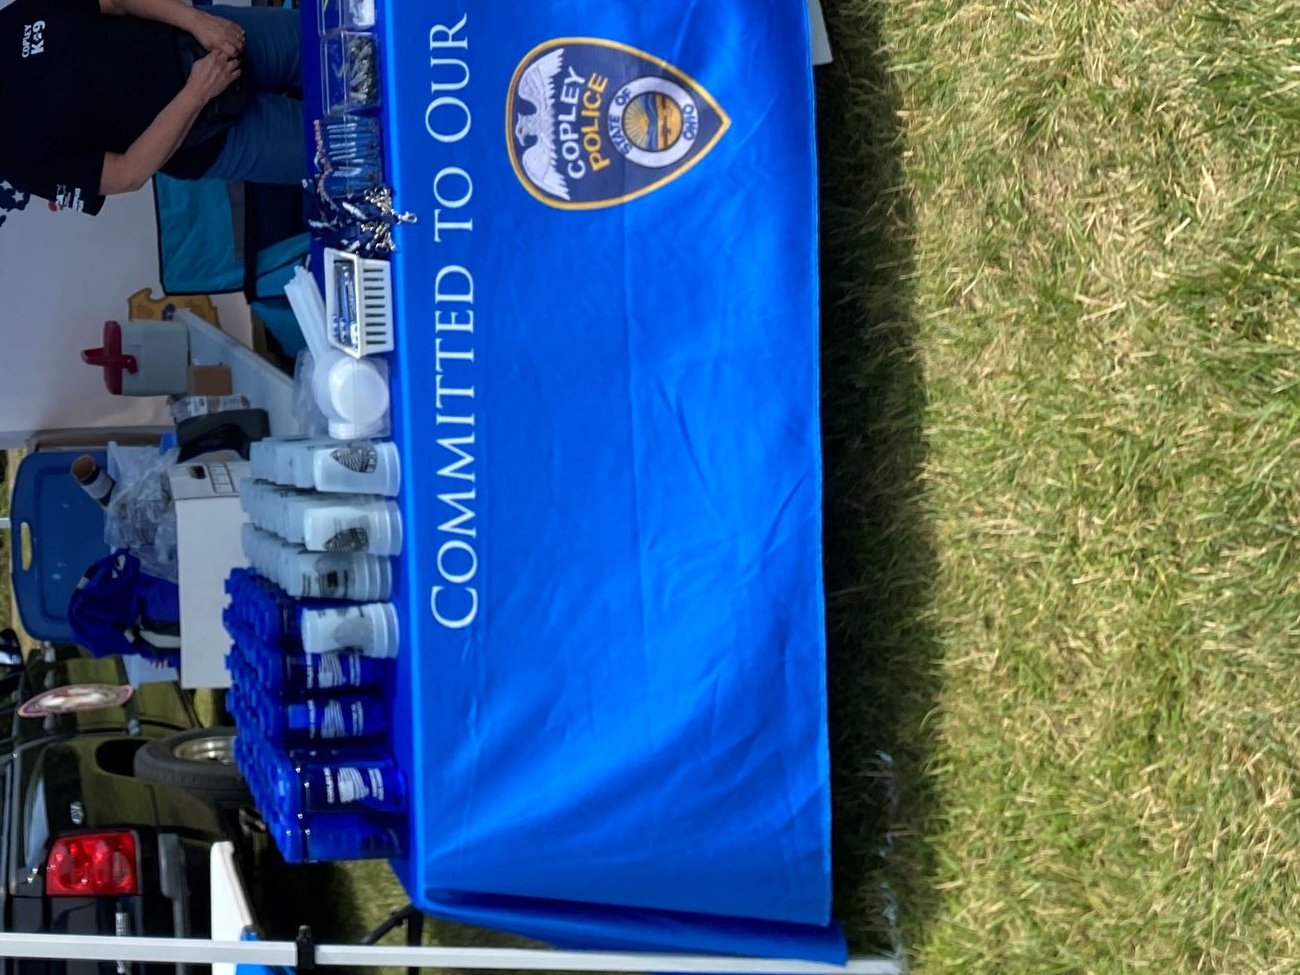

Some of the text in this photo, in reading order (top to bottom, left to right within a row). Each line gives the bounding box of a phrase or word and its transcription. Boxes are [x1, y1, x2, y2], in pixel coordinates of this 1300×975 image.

[21, 24, 32, 58] COPLEY
[424, 12, 472, 144] OUR
[557, 65, 587, 179] COPLEY
[580, 72, 611, 172] POLICE
[608, 87, 633, 154] STATE OF
[682, 103, 697, 141] OHIO
[432, 166, 474, 242] TO
[430, 265, 478, 629] COMMITTED
